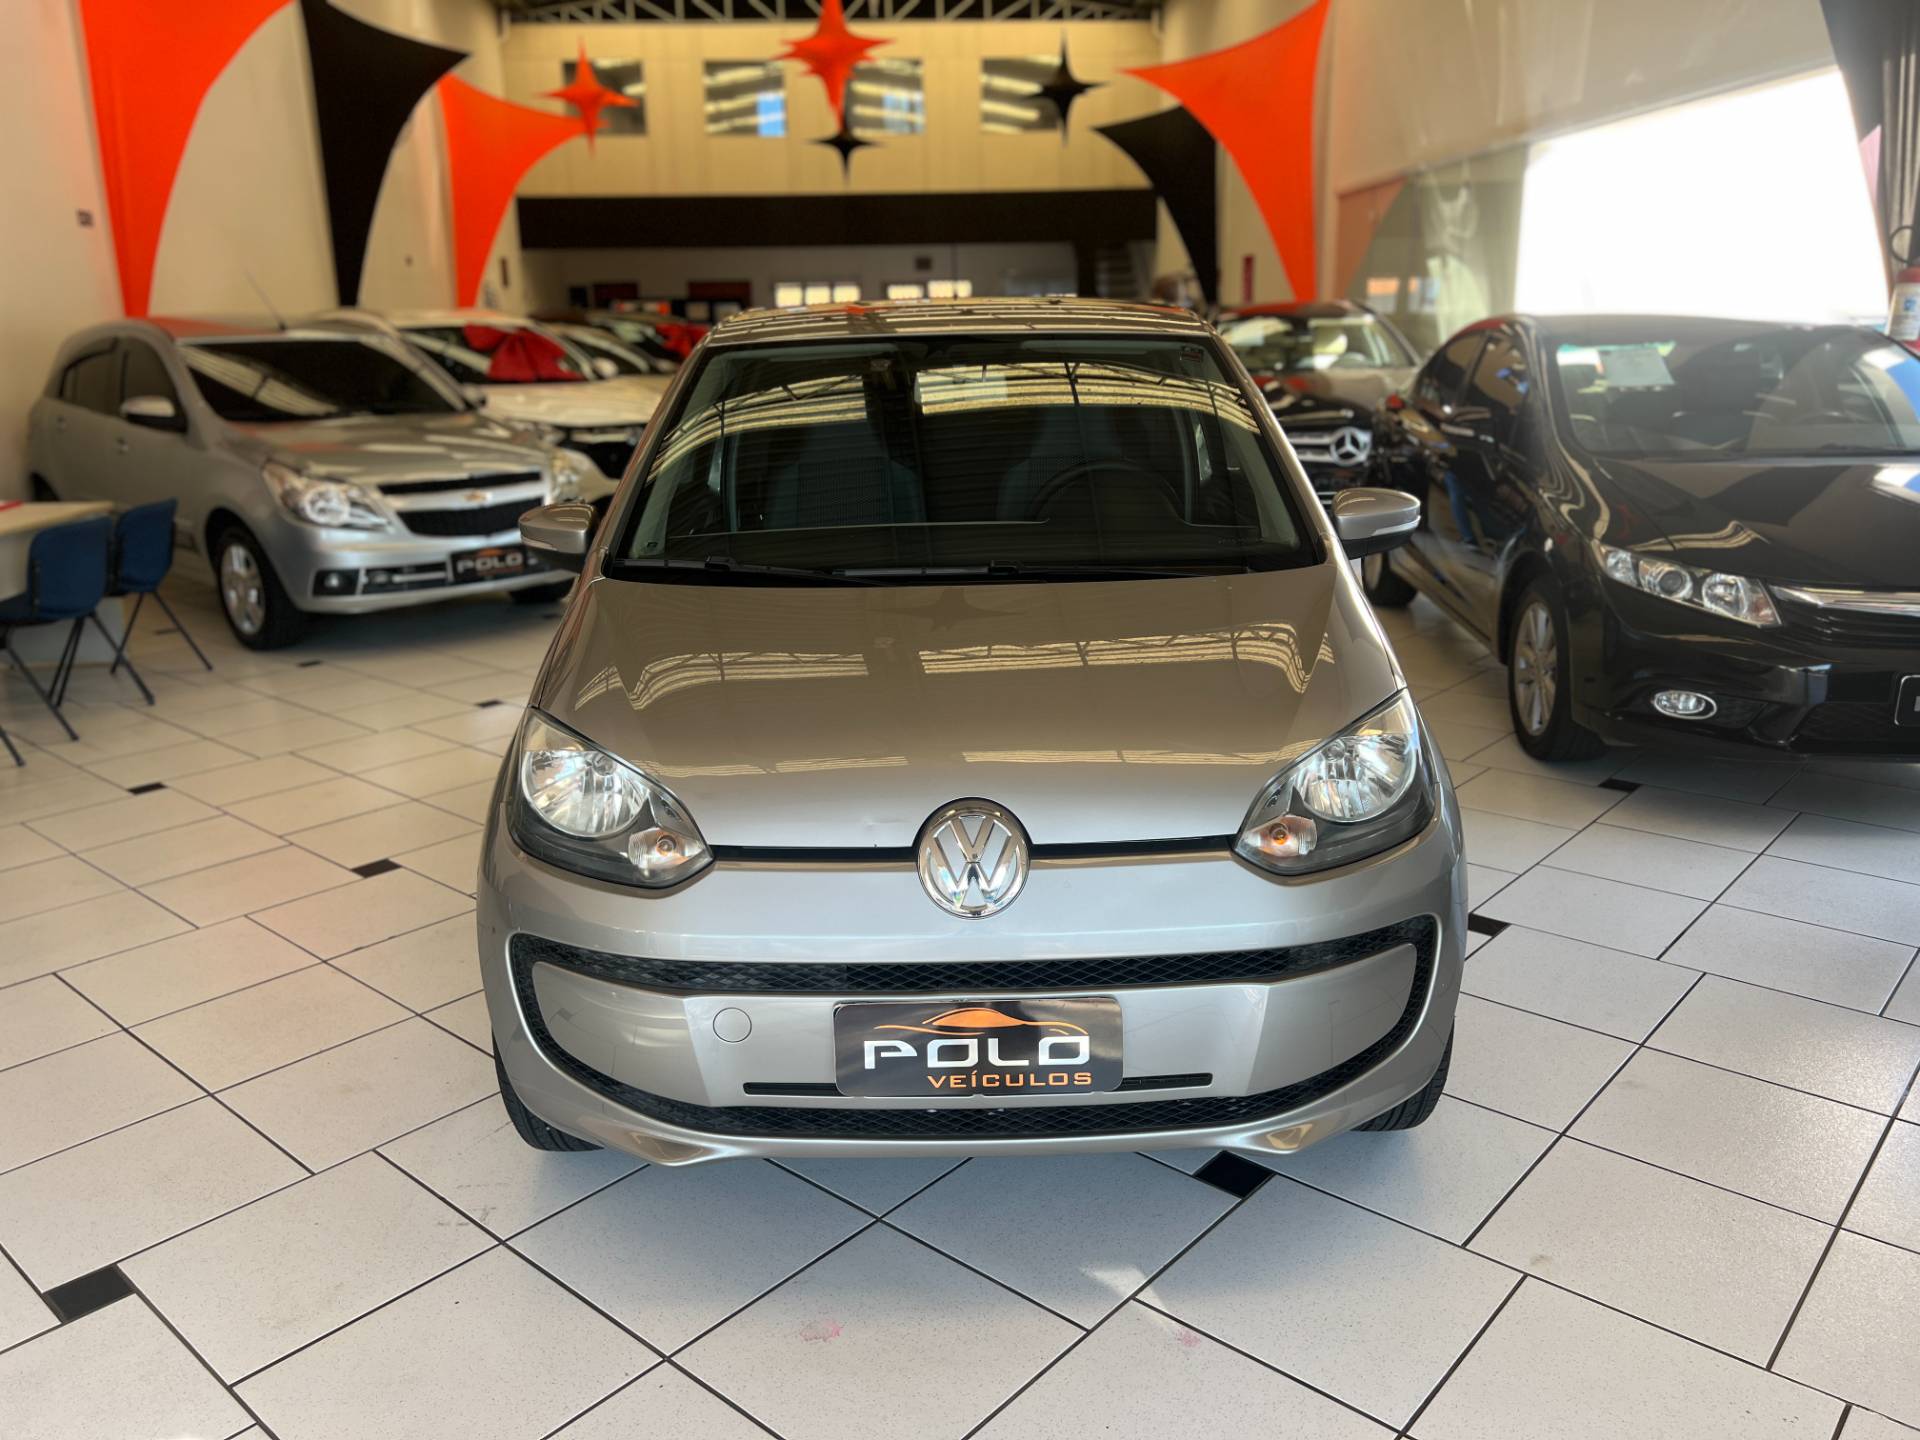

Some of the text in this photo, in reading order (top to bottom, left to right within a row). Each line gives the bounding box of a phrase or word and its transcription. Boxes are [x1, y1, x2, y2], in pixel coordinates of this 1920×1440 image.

[457, 552, 523, 573] POLO
[864, 1035, 1090, 1069] POLO
[927, 1070, 1092, 1088] VEÍCULOS
